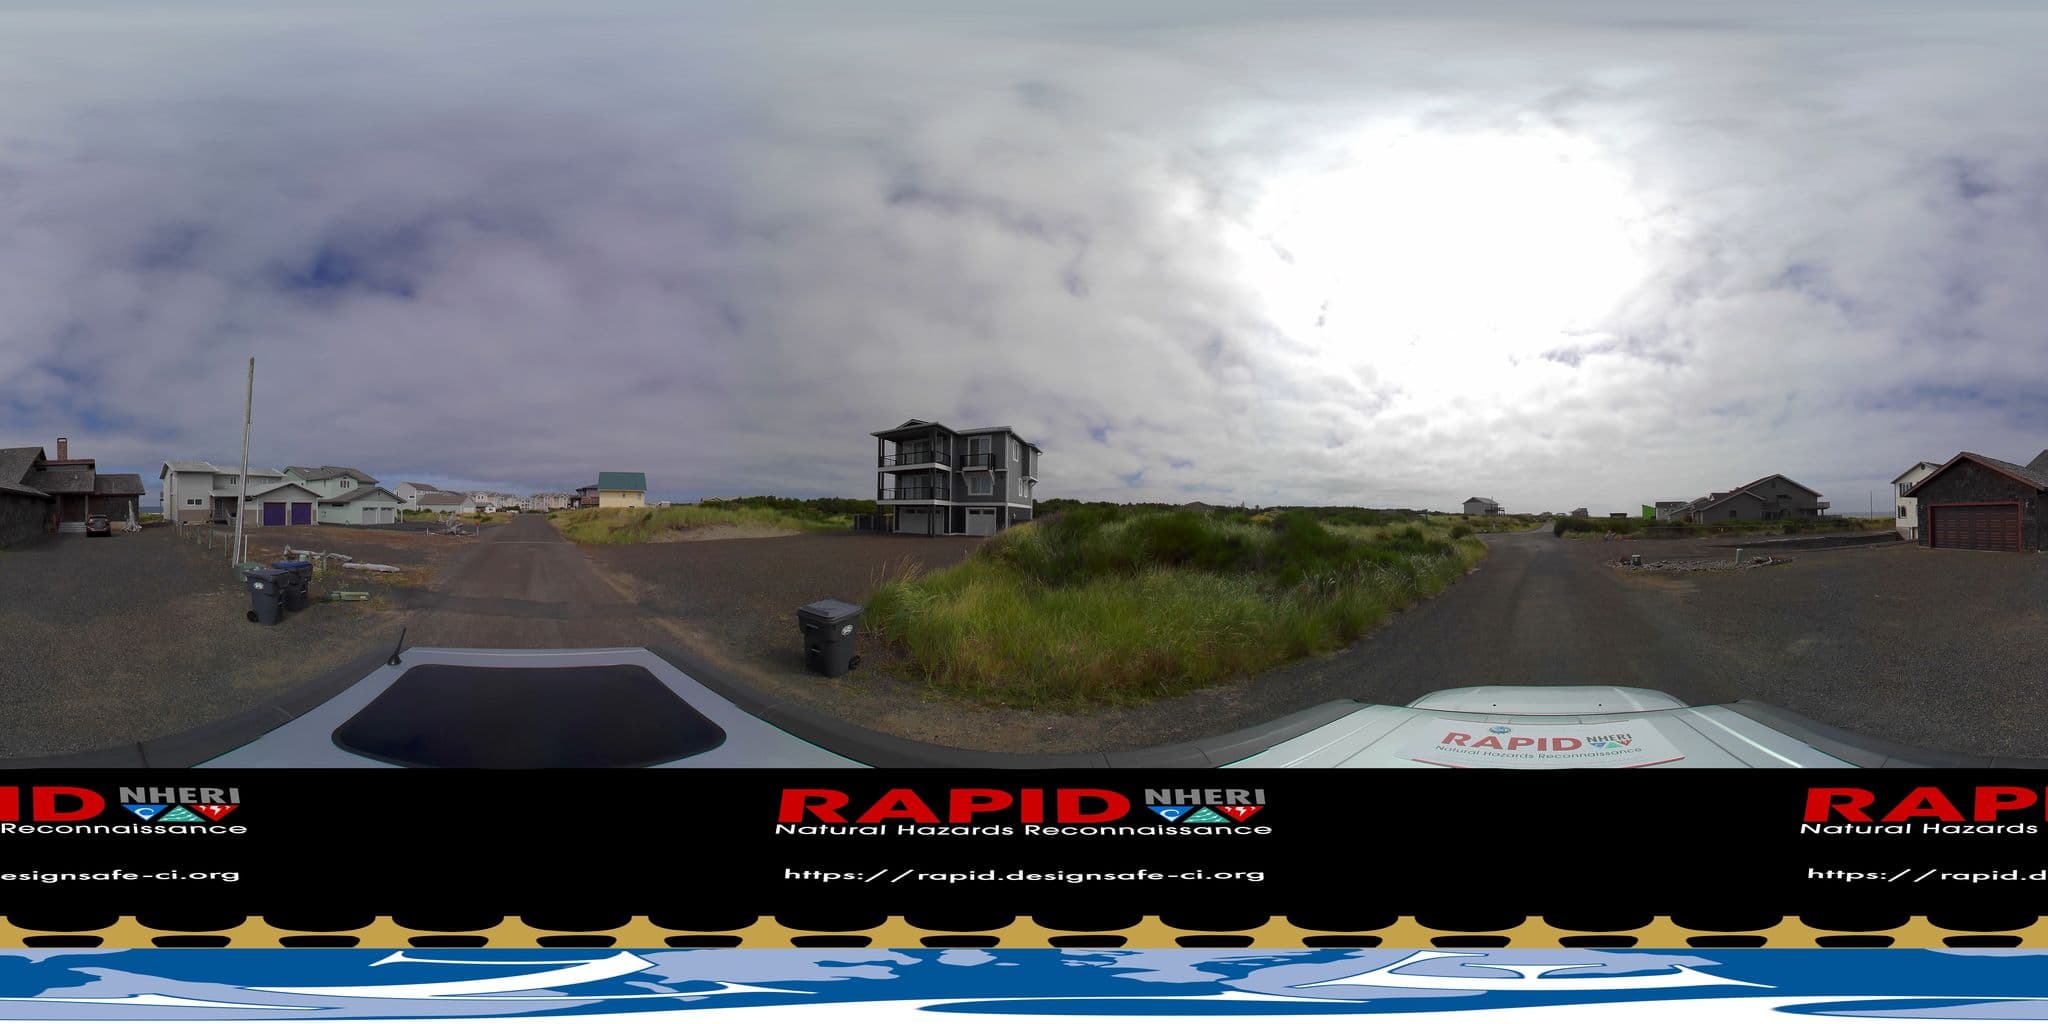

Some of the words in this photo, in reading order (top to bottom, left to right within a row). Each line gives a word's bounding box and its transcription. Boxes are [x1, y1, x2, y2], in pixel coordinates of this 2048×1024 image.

[1441, 732, 1583, 752] RAPID
[1586, 733, 1633, 743] NHERI
[1435, 745, 1480, 756] Natural
[1483, 751, 1534, 759] Hazards
[1538, 747, 1642, 759] Reconnaissance
